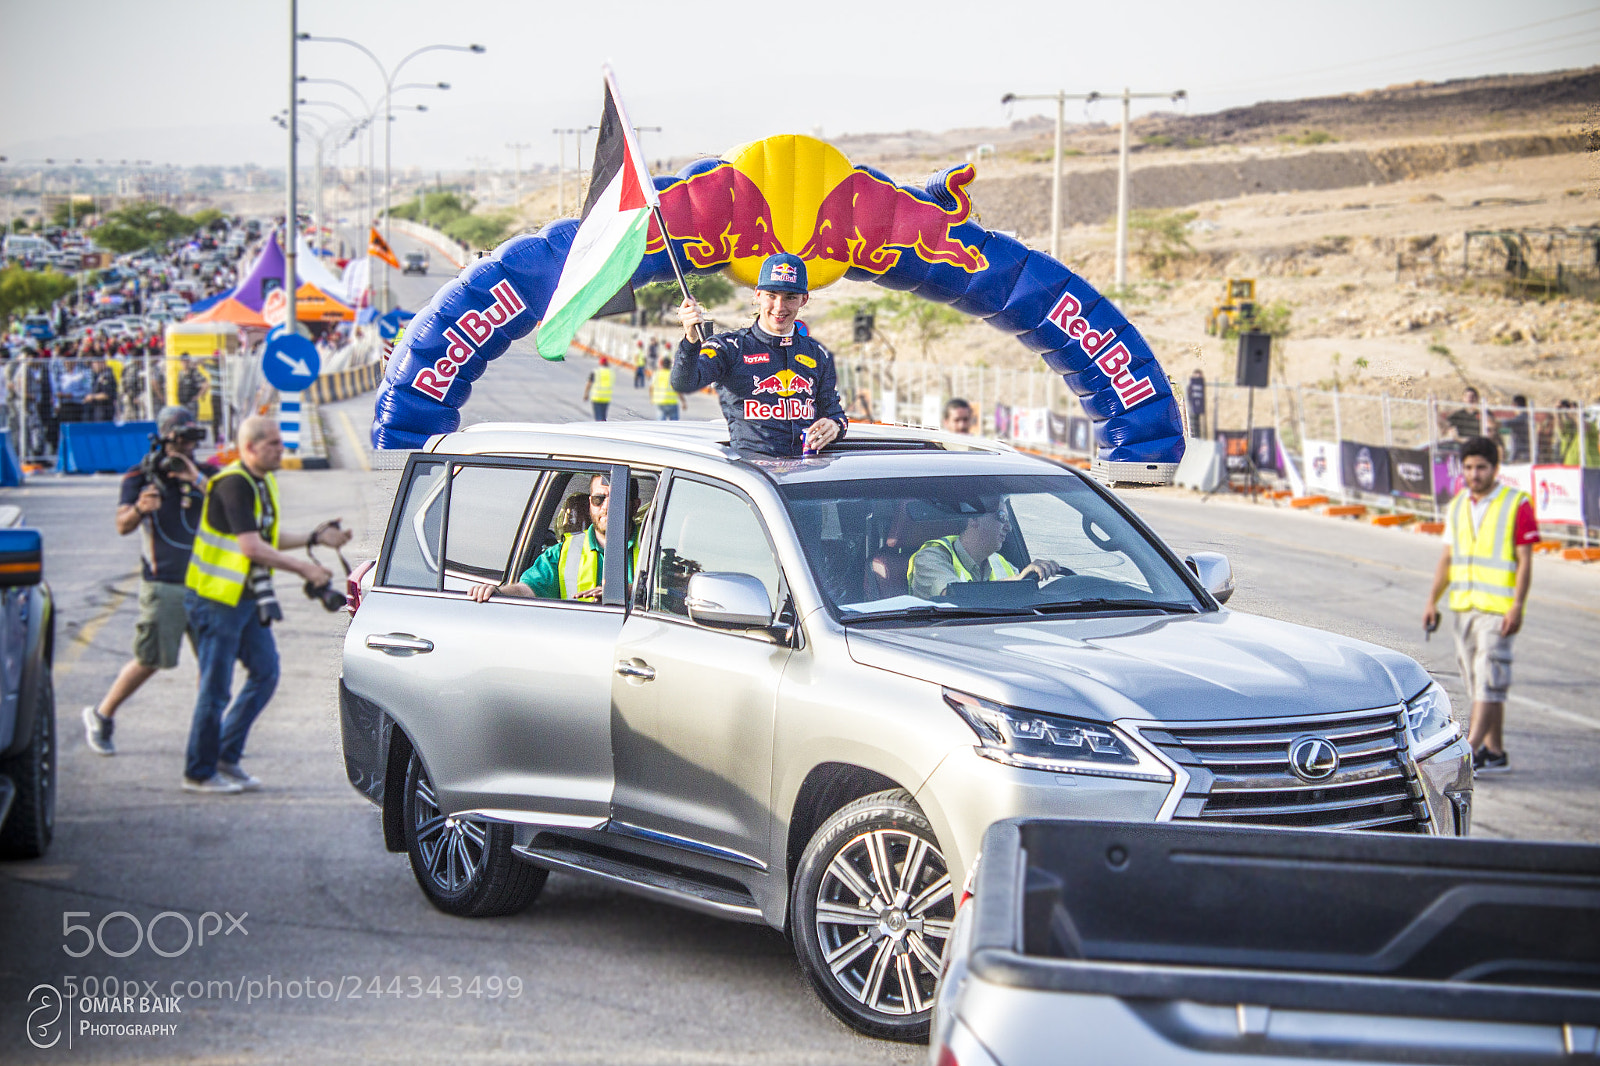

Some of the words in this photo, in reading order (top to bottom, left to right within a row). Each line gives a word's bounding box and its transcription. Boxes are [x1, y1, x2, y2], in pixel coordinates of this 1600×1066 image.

[412, 327, 475, 402] Red
[456, 279, 526, 347] Bull
[744, 355, 770, 363] TOTAL
[1047, 292, 1116, 359] Red
[1095, 341, 1156, 410] Bull
[744, 399, 786, 420] Red
[816, 809, 884, 852] DUNLOP
